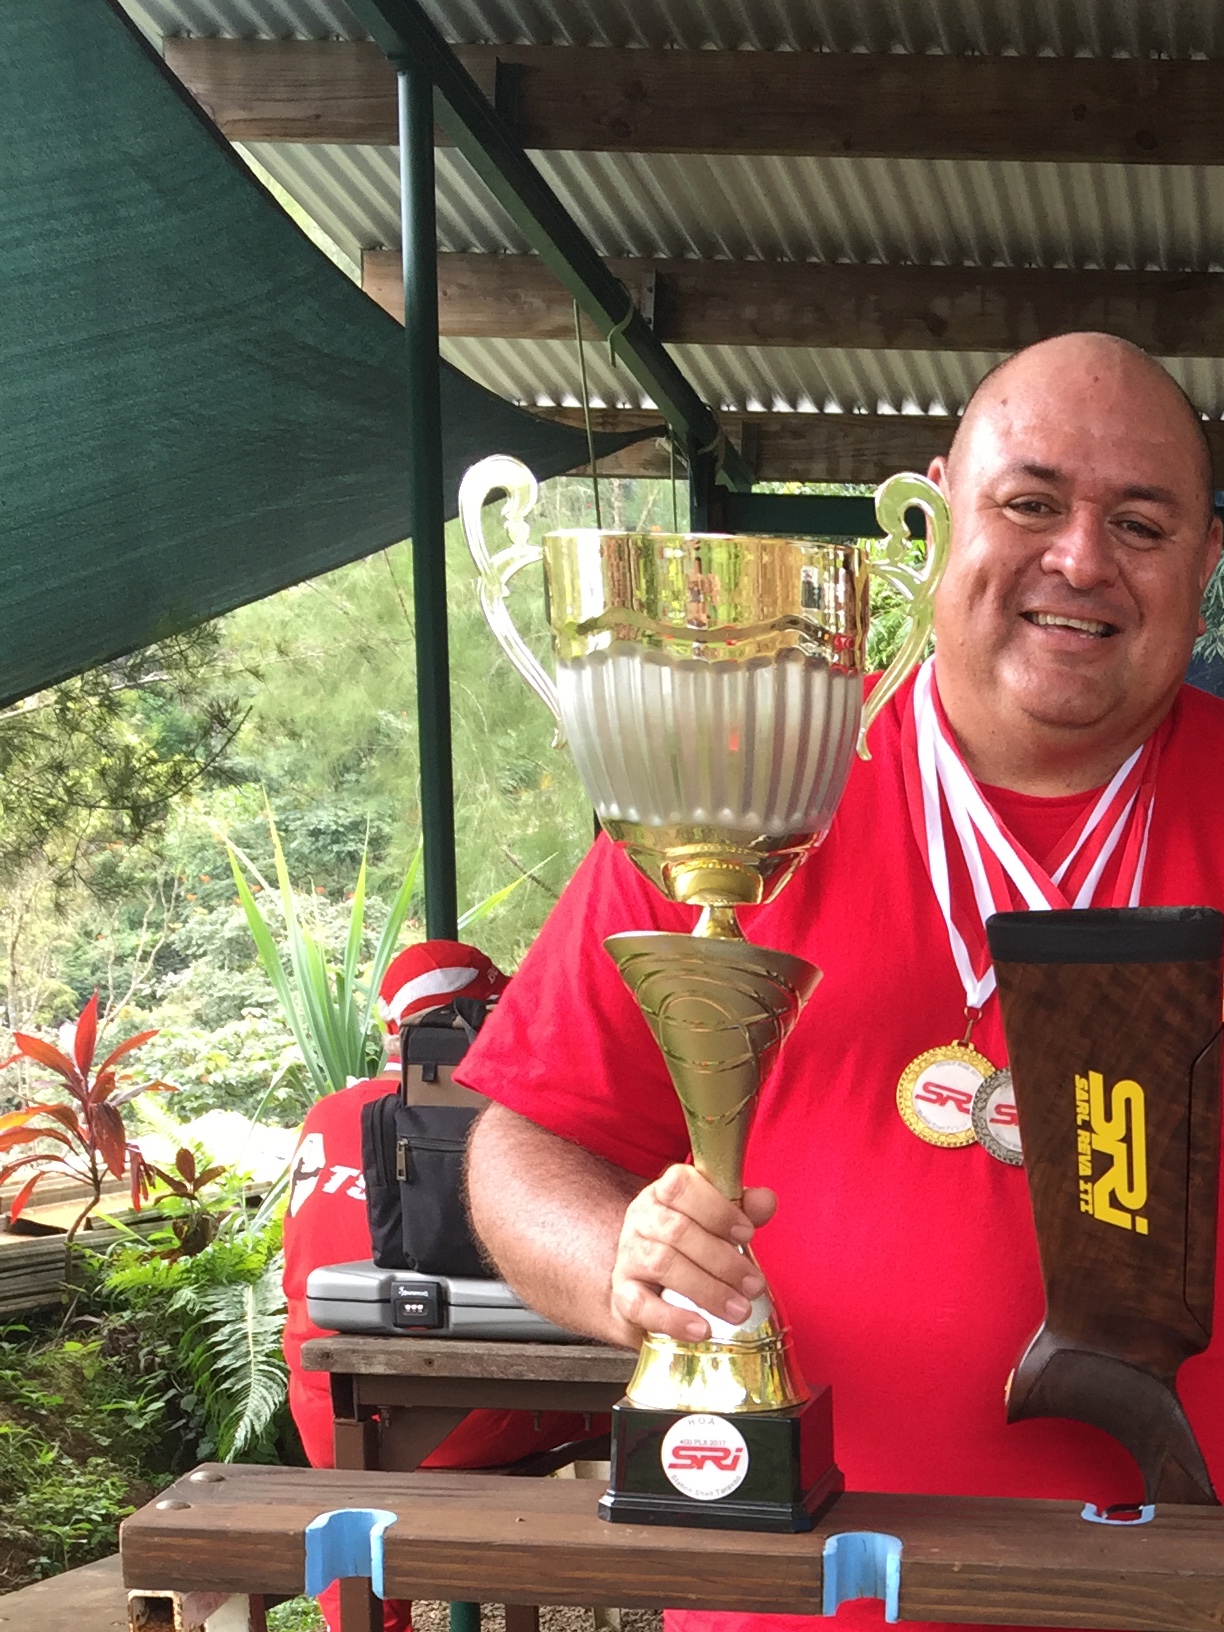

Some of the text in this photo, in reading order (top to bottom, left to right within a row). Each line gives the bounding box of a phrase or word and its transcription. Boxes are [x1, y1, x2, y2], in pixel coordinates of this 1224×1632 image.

[1074, 1073, 1094, 1215] SARL REVA ITI
[709, 1439, 727, 1447] 2017
[670, 1474, 694, 1494] Station
[715, 1475, 742, 1497] Taravao
